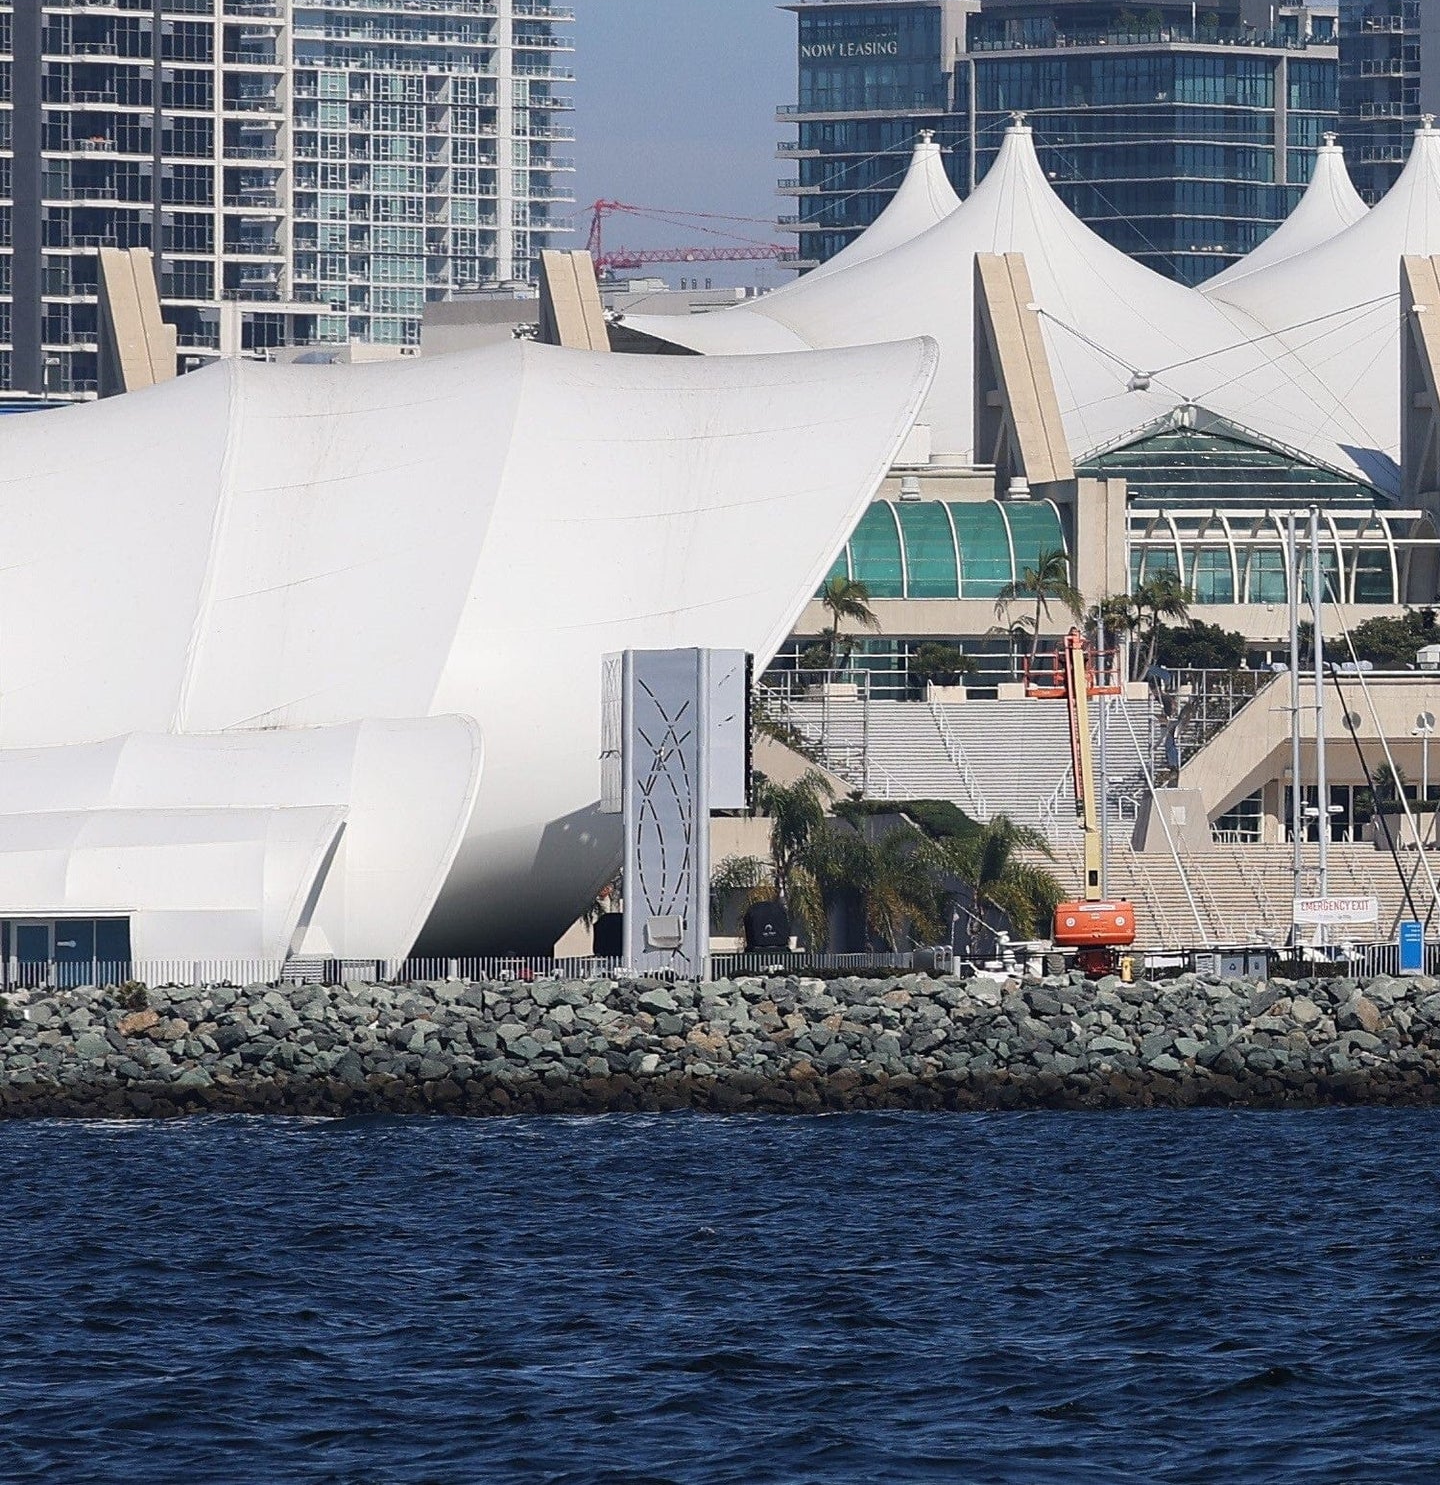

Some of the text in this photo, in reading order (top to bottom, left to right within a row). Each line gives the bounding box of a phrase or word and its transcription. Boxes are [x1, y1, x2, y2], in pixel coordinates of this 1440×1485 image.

[801, 41, 897, 58] NOW LEASING
[1301, 899, 1369, 912] EMERGENCY EXIT
